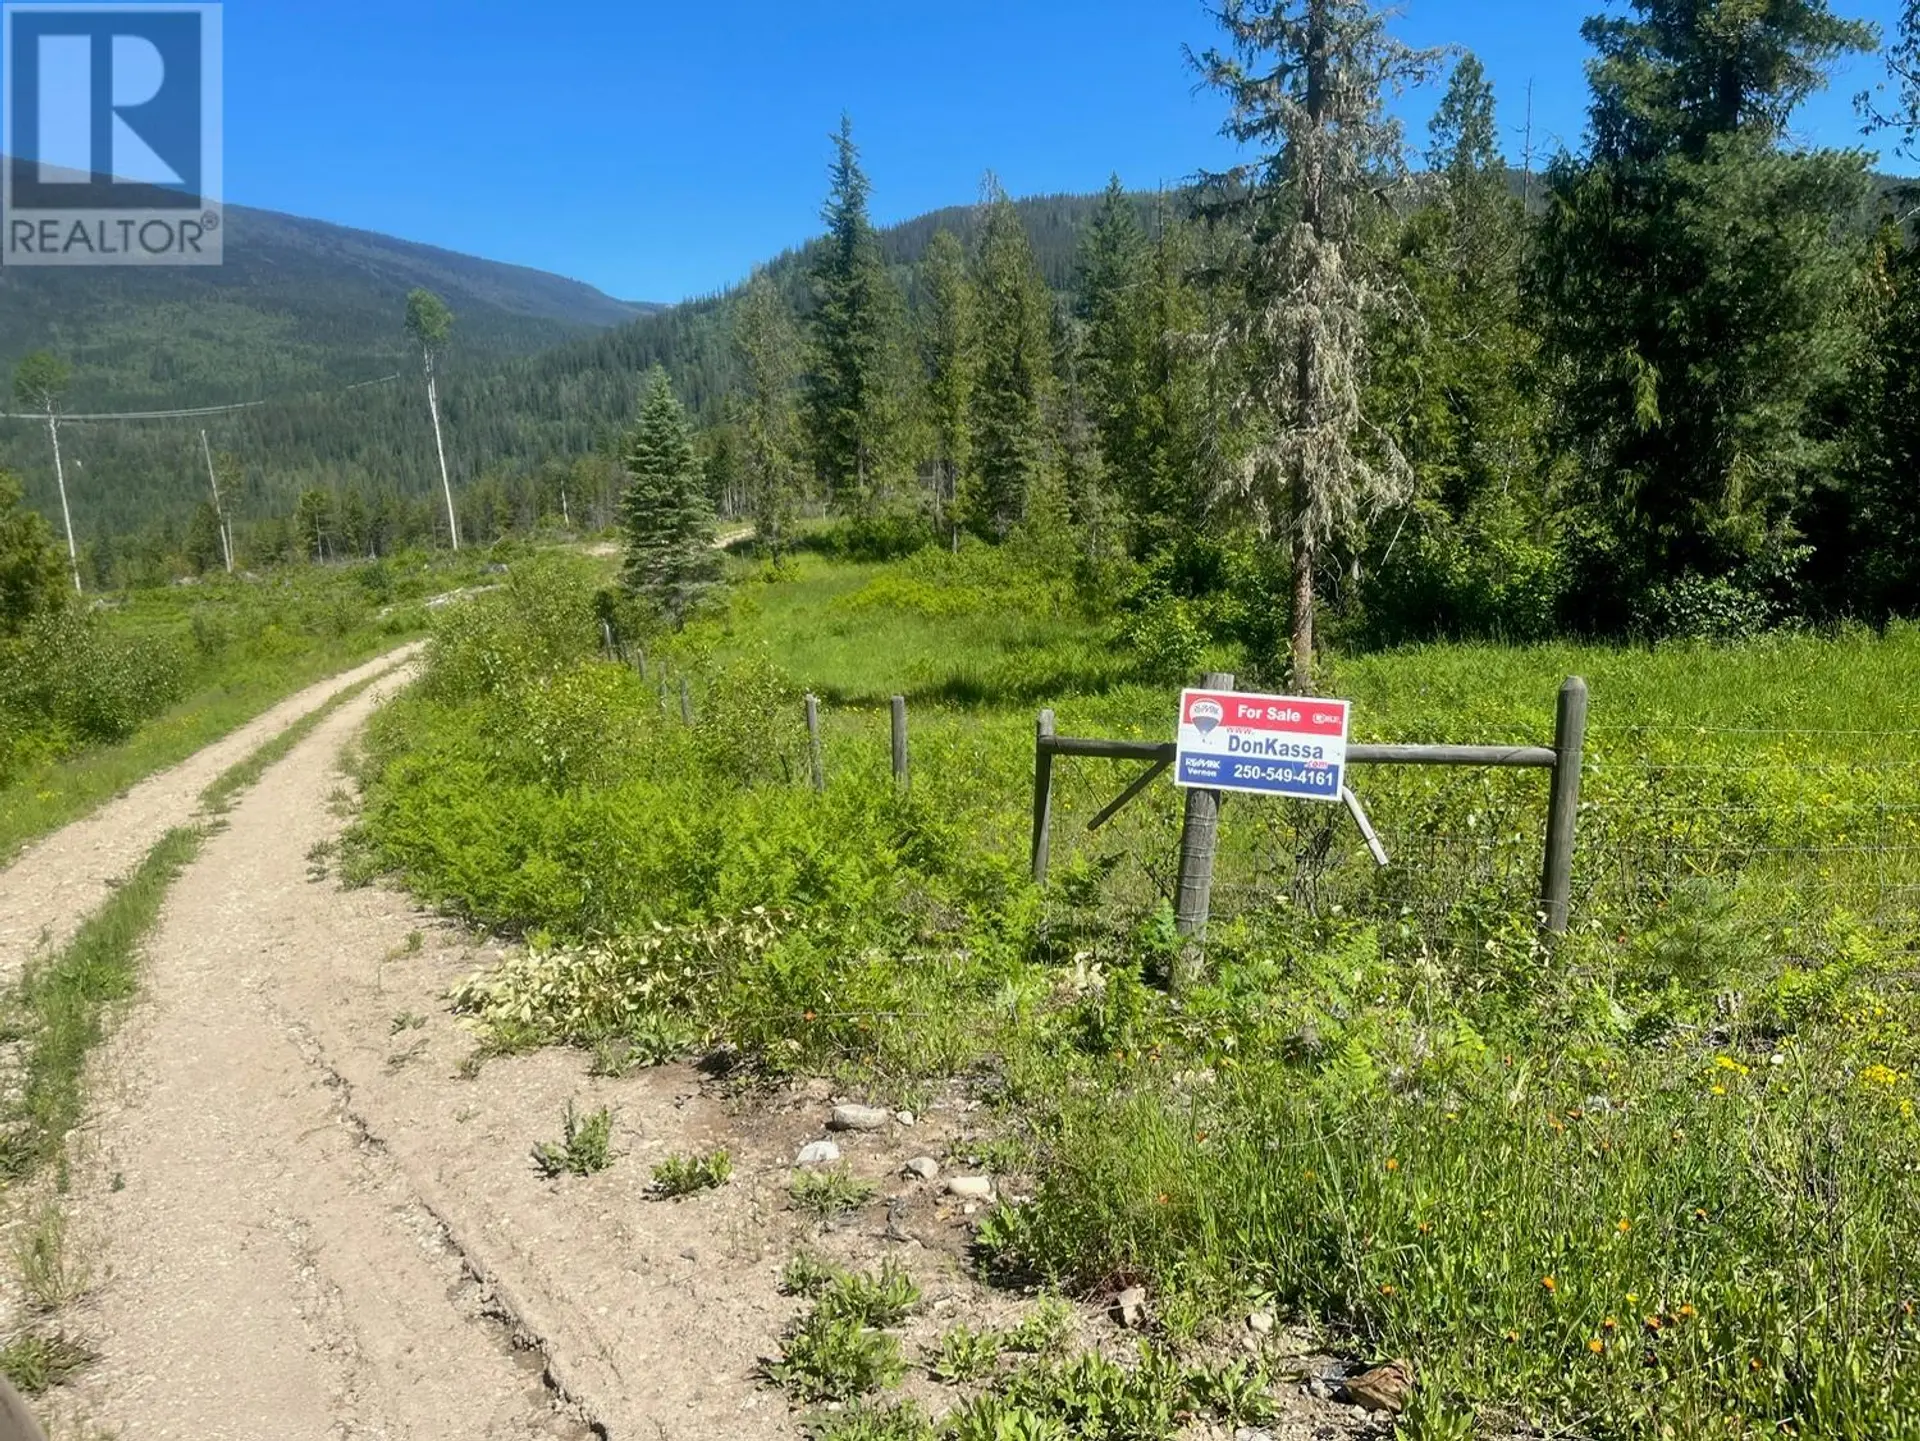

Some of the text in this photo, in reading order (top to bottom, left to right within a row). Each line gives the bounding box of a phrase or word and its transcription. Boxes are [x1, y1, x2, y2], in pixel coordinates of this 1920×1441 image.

[1237, 704, 1262, 720] For
[1266, 708, 1301, 723] Sale
[1228, 734, 1324, 760] DonKassa
[1187, 767, 1218, 778] Vernon
[1233, 763, 1334, 787] 250-549-4161
